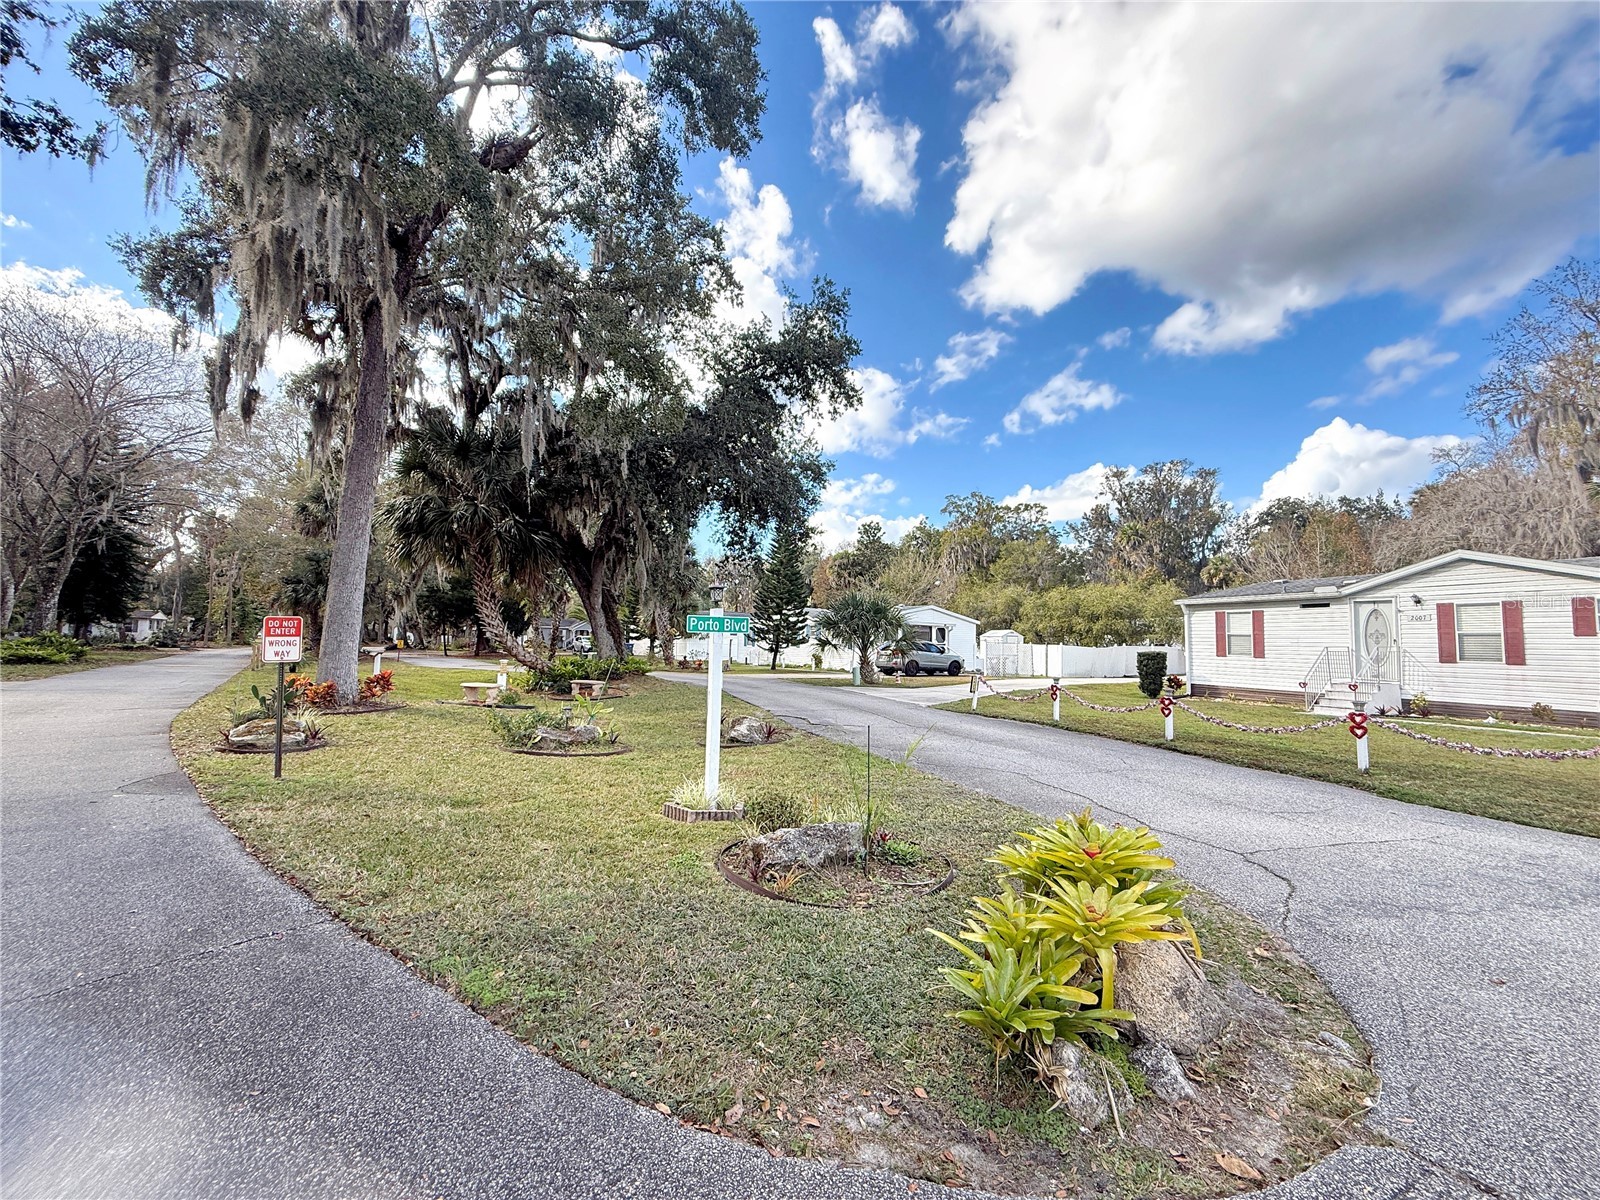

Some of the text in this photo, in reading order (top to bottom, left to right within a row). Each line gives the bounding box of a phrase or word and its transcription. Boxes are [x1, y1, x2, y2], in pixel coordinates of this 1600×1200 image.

[268, 620, 299, 628] DO NOT
[689, 617, 747, 632] Porto Blvd
[270, 627, 296, 635] ENTER
[267, 639, 298, 647] WRONG
[273, 650, 291, 658] WAY
